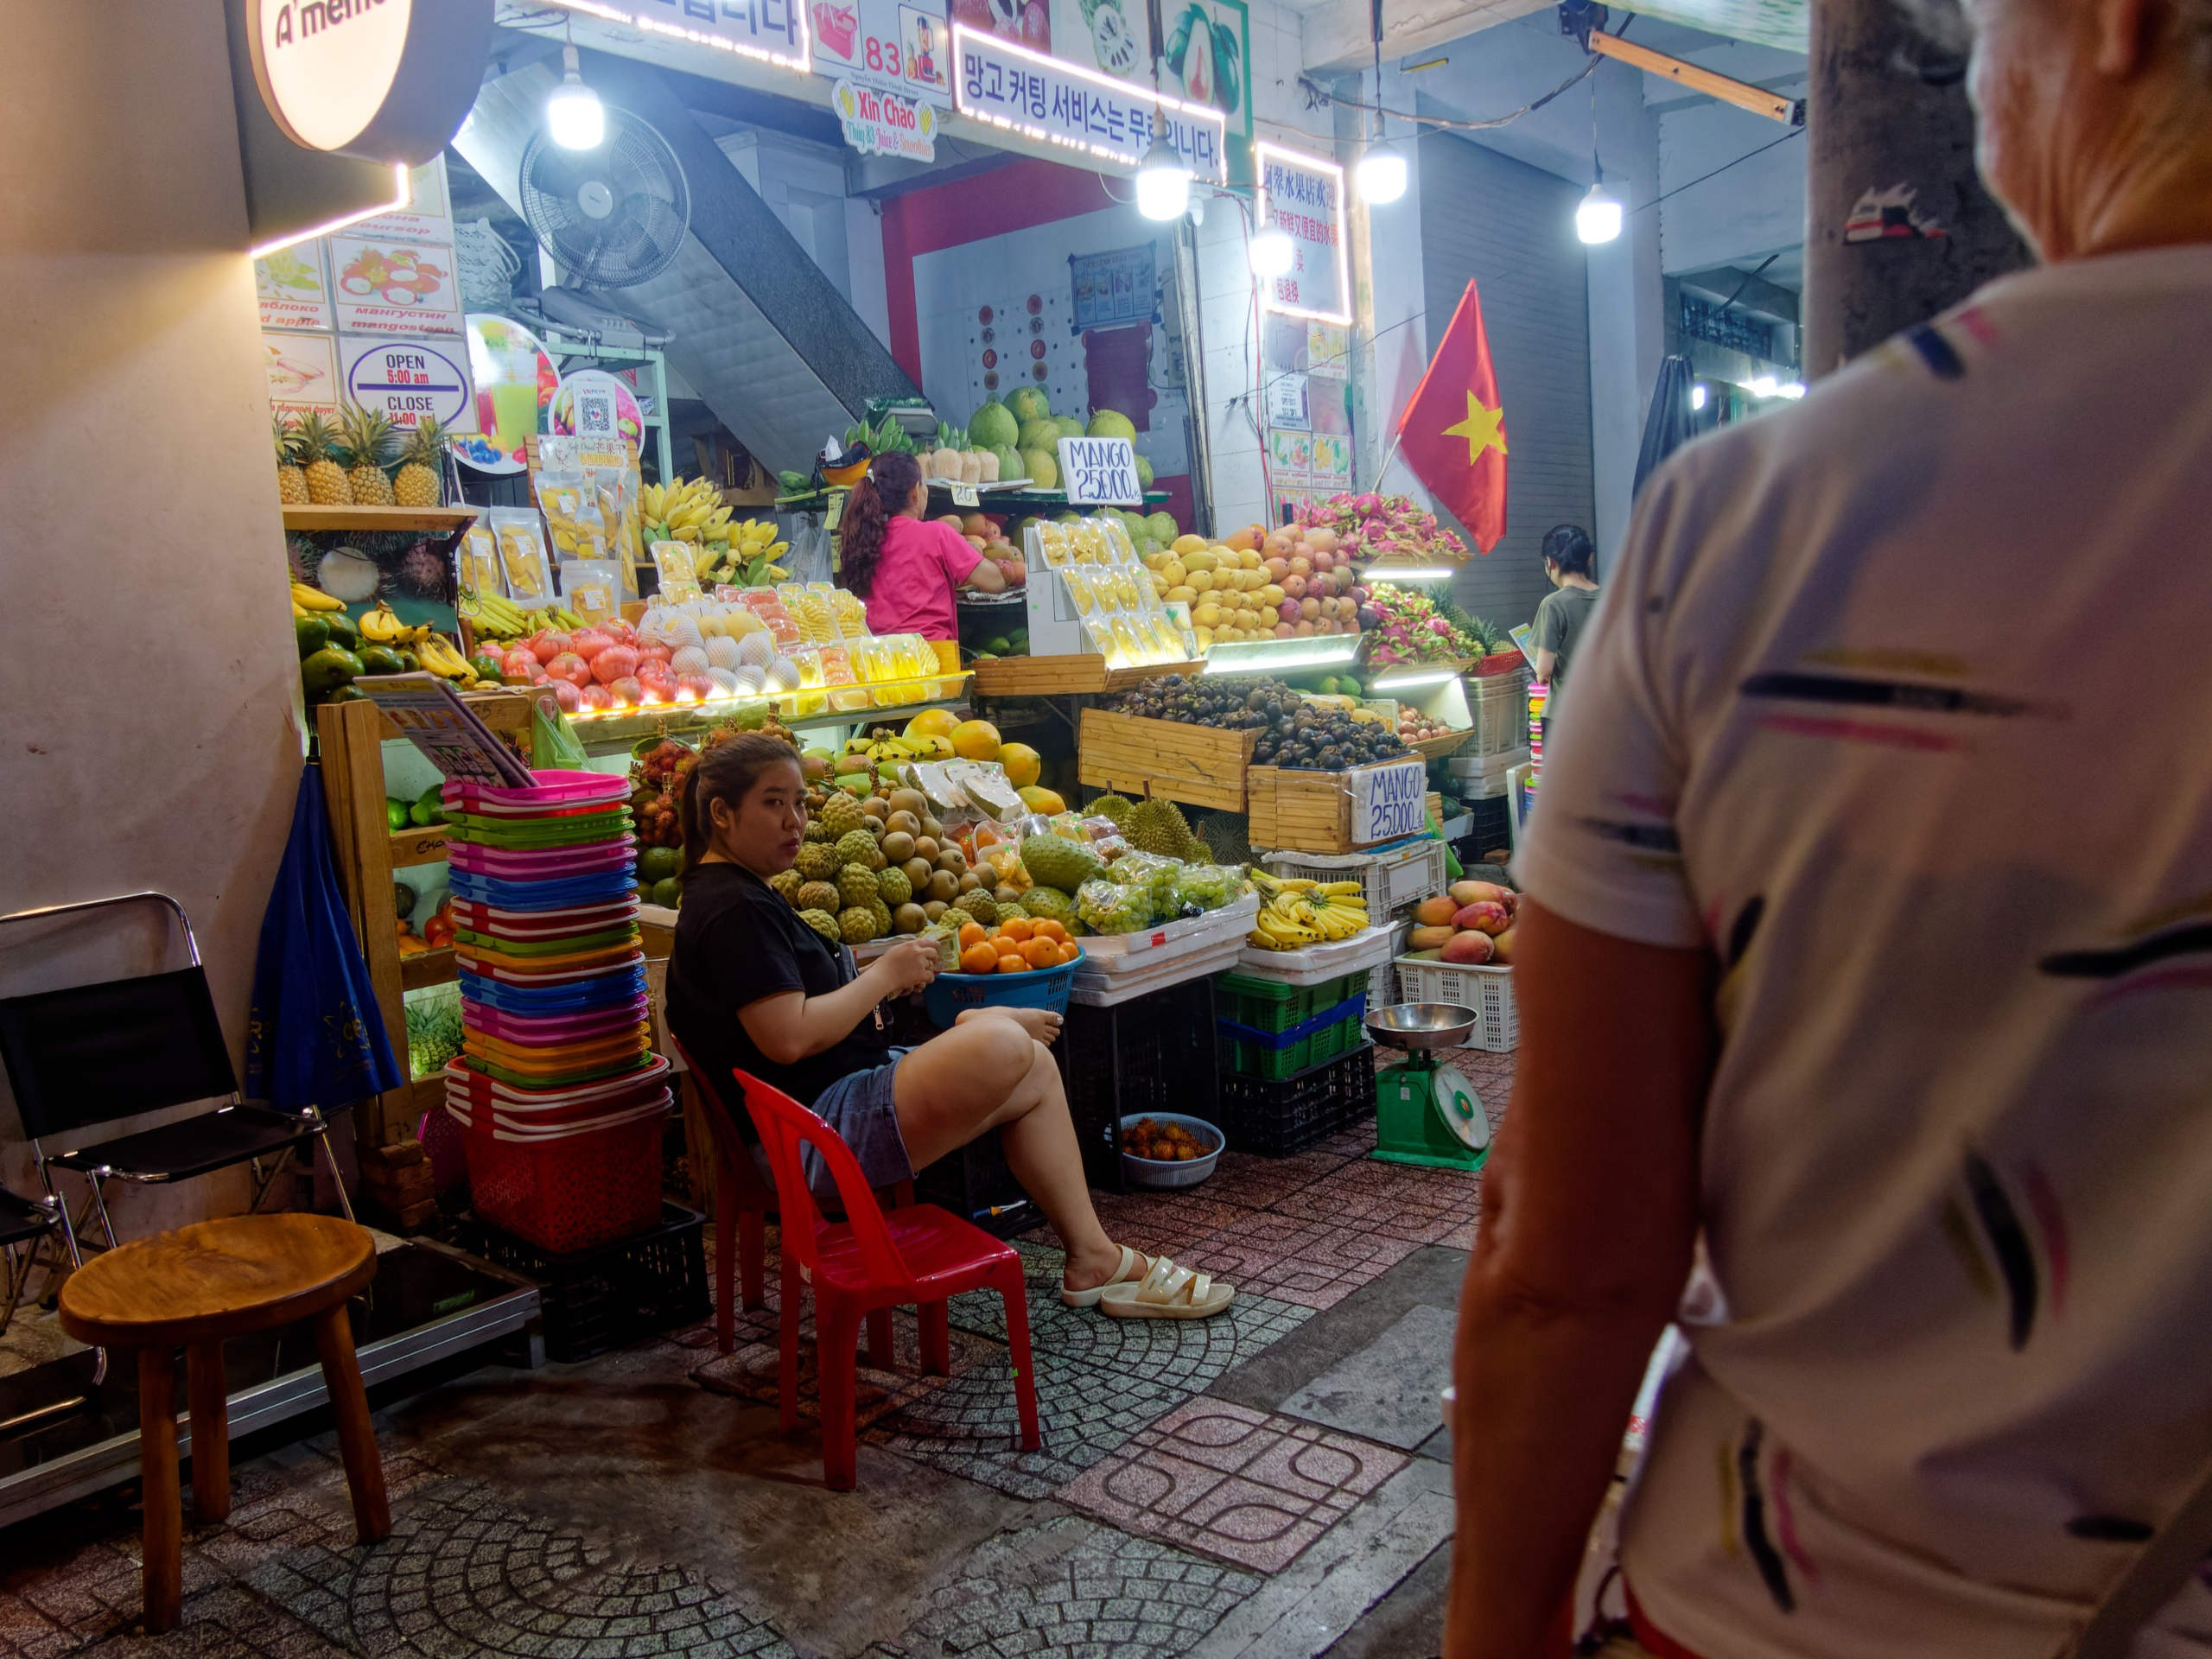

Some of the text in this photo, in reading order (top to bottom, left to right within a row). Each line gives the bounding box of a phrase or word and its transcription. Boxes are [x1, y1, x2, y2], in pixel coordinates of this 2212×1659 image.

[865, 35, 901, 77] 83
[963, 52, 1005, 103] 망고
[1009, 69, 1046, 120] 커팅
[1052, 84, 1124, 143] 서비스는
[865, 124, 875, 144] 83
[875, 128, 893, 151] Juice
[355, 306, 448, 321] мангустин
[351, 320, 455, 334] mangosteen
[385, 354, 426, 370] OPEN
[386, 370, 429, 385] 5:00 am
[387, 396, 434, 410] CLOSE
[1070, 441, 1130, 468] MANGO
[1370, 766, 1421, 806] MANGO
